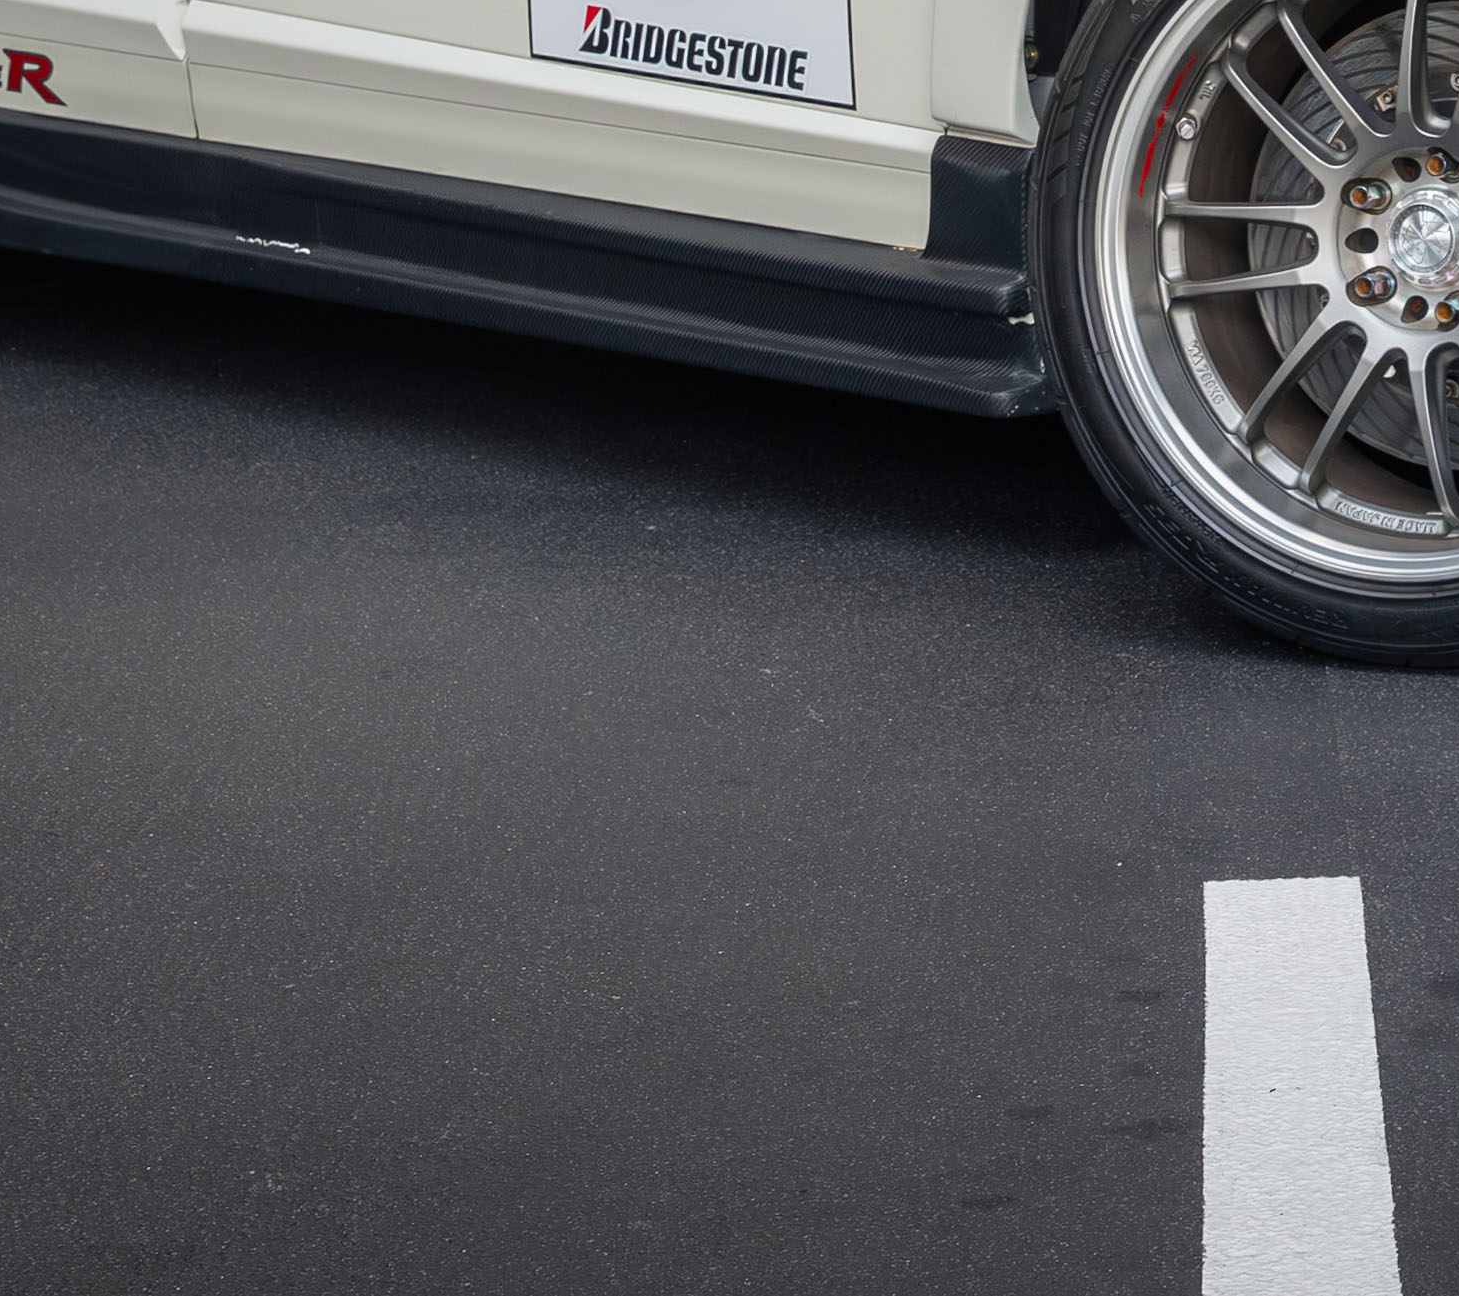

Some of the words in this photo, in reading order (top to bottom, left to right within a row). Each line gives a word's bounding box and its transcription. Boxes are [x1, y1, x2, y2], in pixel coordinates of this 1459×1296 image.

[2, 48, 69, 107] R
[578, 4, 809, 92] BRIDGESTONE
[1335, 501, 1381, 526] JAPAN
